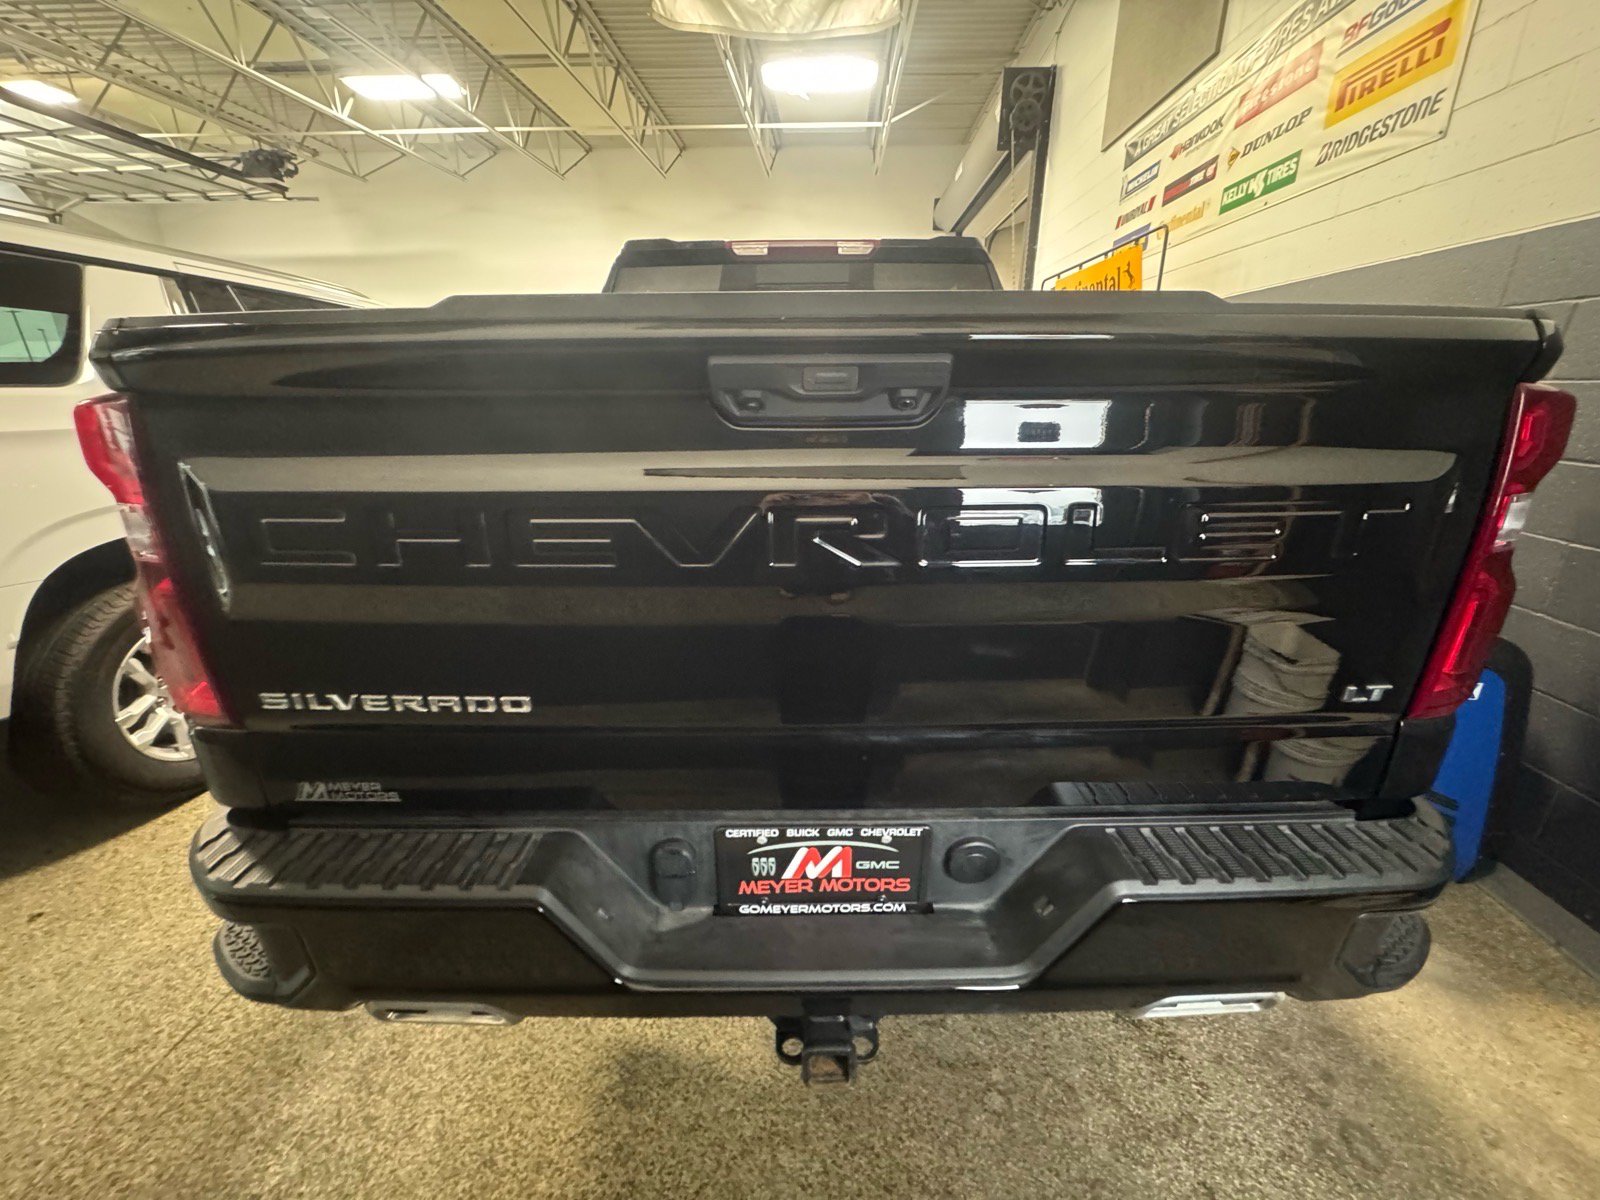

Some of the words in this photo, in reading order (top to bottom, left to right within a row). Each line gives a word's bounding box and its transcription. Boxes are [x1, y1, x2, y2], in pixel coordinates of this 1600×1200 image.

[1334, 17, 1452, 113] PIRELLI
[1240, 106, 1314, 159] DUNLOP
[1315, 87, 1448, 168] BRIDGESTONE
[1222, 180, 1250, 207] KELLY
[1266, 156, 1298, 186] TIRES
[258, 503, 1412, 569] CHEVROLET
[258, 692, 532, 713] SILVERADO
[1341, 684, 1394, 702] LT
[725, 828, 780, 839] CERTIFIED
[786, 828, 820, 838] BUICK
[827, 828, 854, 838] GMC
[860, 828, 924, 838] CHEVROLET
[855, 860, 900, 870] GMC
[738, 879, 814, 895] MEYER
[819, 877, 911, 893] MOTORS
[738, 902, 907, 914] GOMEYERMOTORS.COM
